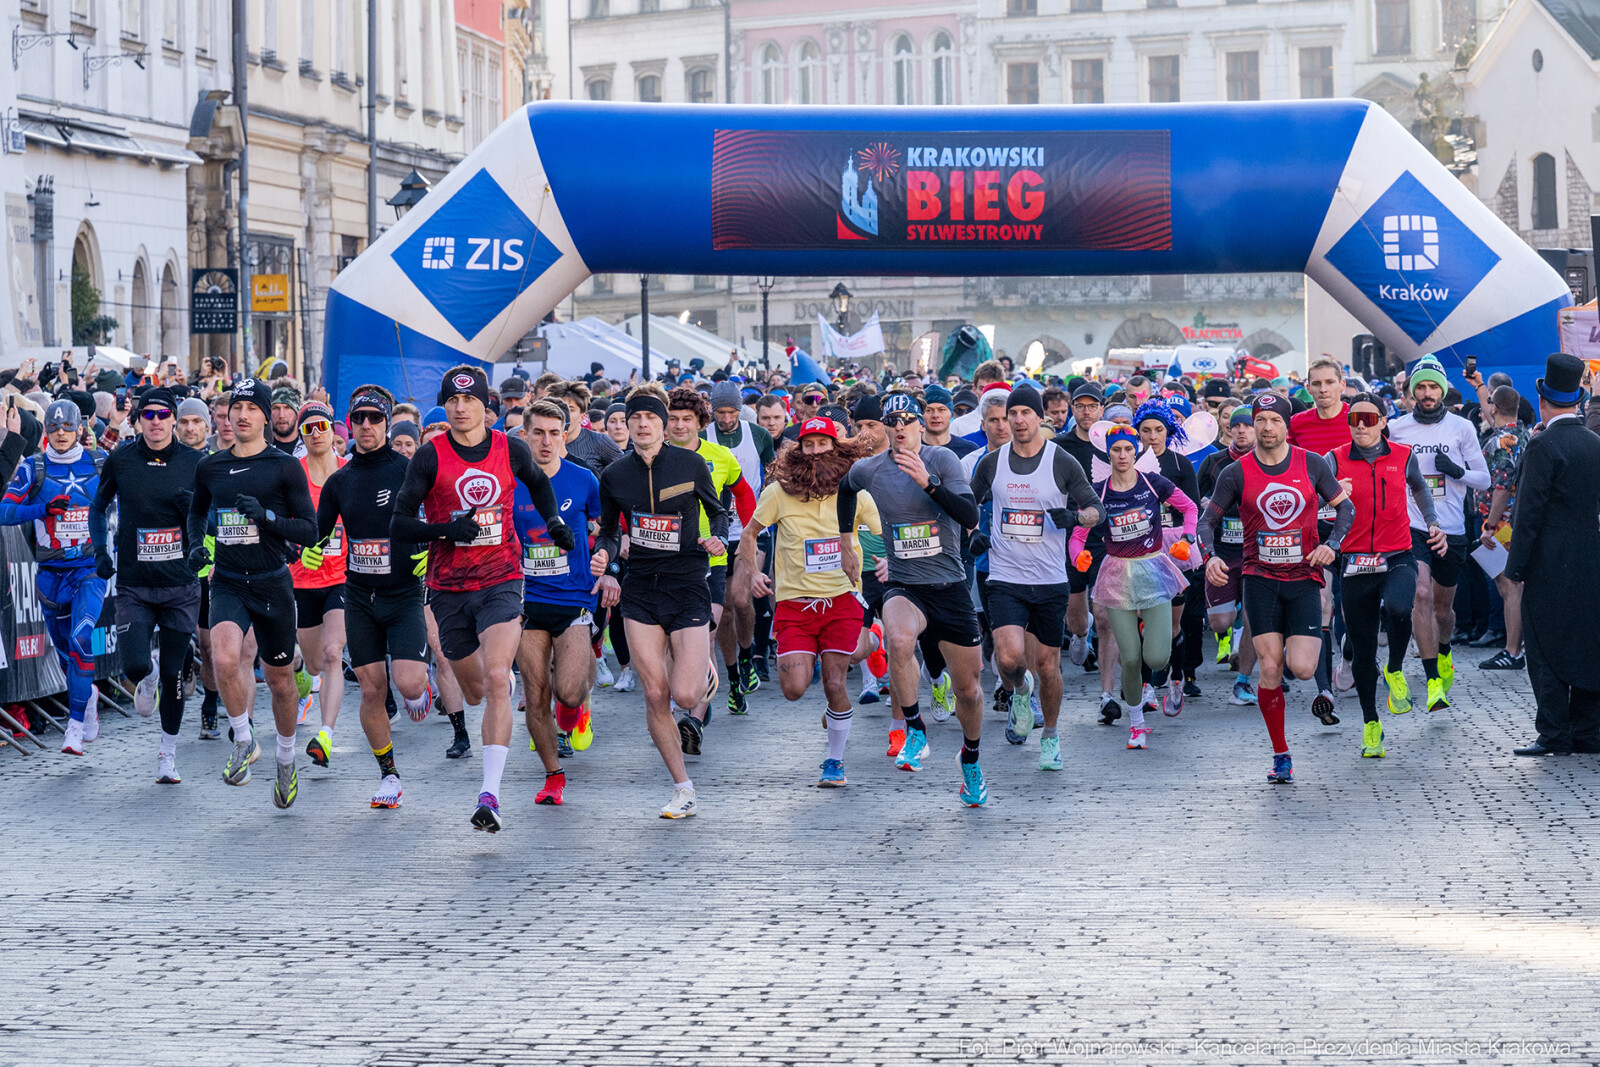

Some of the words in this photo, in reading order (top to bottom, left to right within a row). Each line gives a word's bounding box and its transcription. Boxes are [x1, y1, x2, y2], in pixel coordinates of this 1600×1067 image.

[907, 147, 1045, 167] KRAKOWSKI
[907, 170, 1045, 221] BIEG
[907, 225, 1044, 241] SYLWESTROWY
[466, 238, 524, 271] ZIS
[1379, 283, 1449, 301] Kraków
[54, 407, 64, 420] A
[64, 511, 89, 522] 3292
[224, 513, 246, 525] 1307
[1009, 513, 1035, 525] 2002
[1115, 512, 1140, 526] 3762
[642, 518, 669, 531] 3917
[1120, 524, 1139, 534] MAJA
[222, 526, 249, 537] BARTOSZ
[638, 529, 671, 542] MATEUSZ
[904, 526, 925, 539] 987
[147, 532, 173, 544] 2770
[1265, 536, 1292, 547] 2283
[139, 543, 181, 555] PRZEMYSŁAW
[353, 544, 380, 555] 3024
[817, 542, 839, 554] 3611
[902, 539, 930, 550] MARCIN
[532, 547, 556, 558] 1017
[818, 554, 838, 562] GUMP
[1269, 548, 1290, 556] PIOTR
[353, 556, 383, 566] MARTYKA
[534, 559, 556, 568] JAKUB
